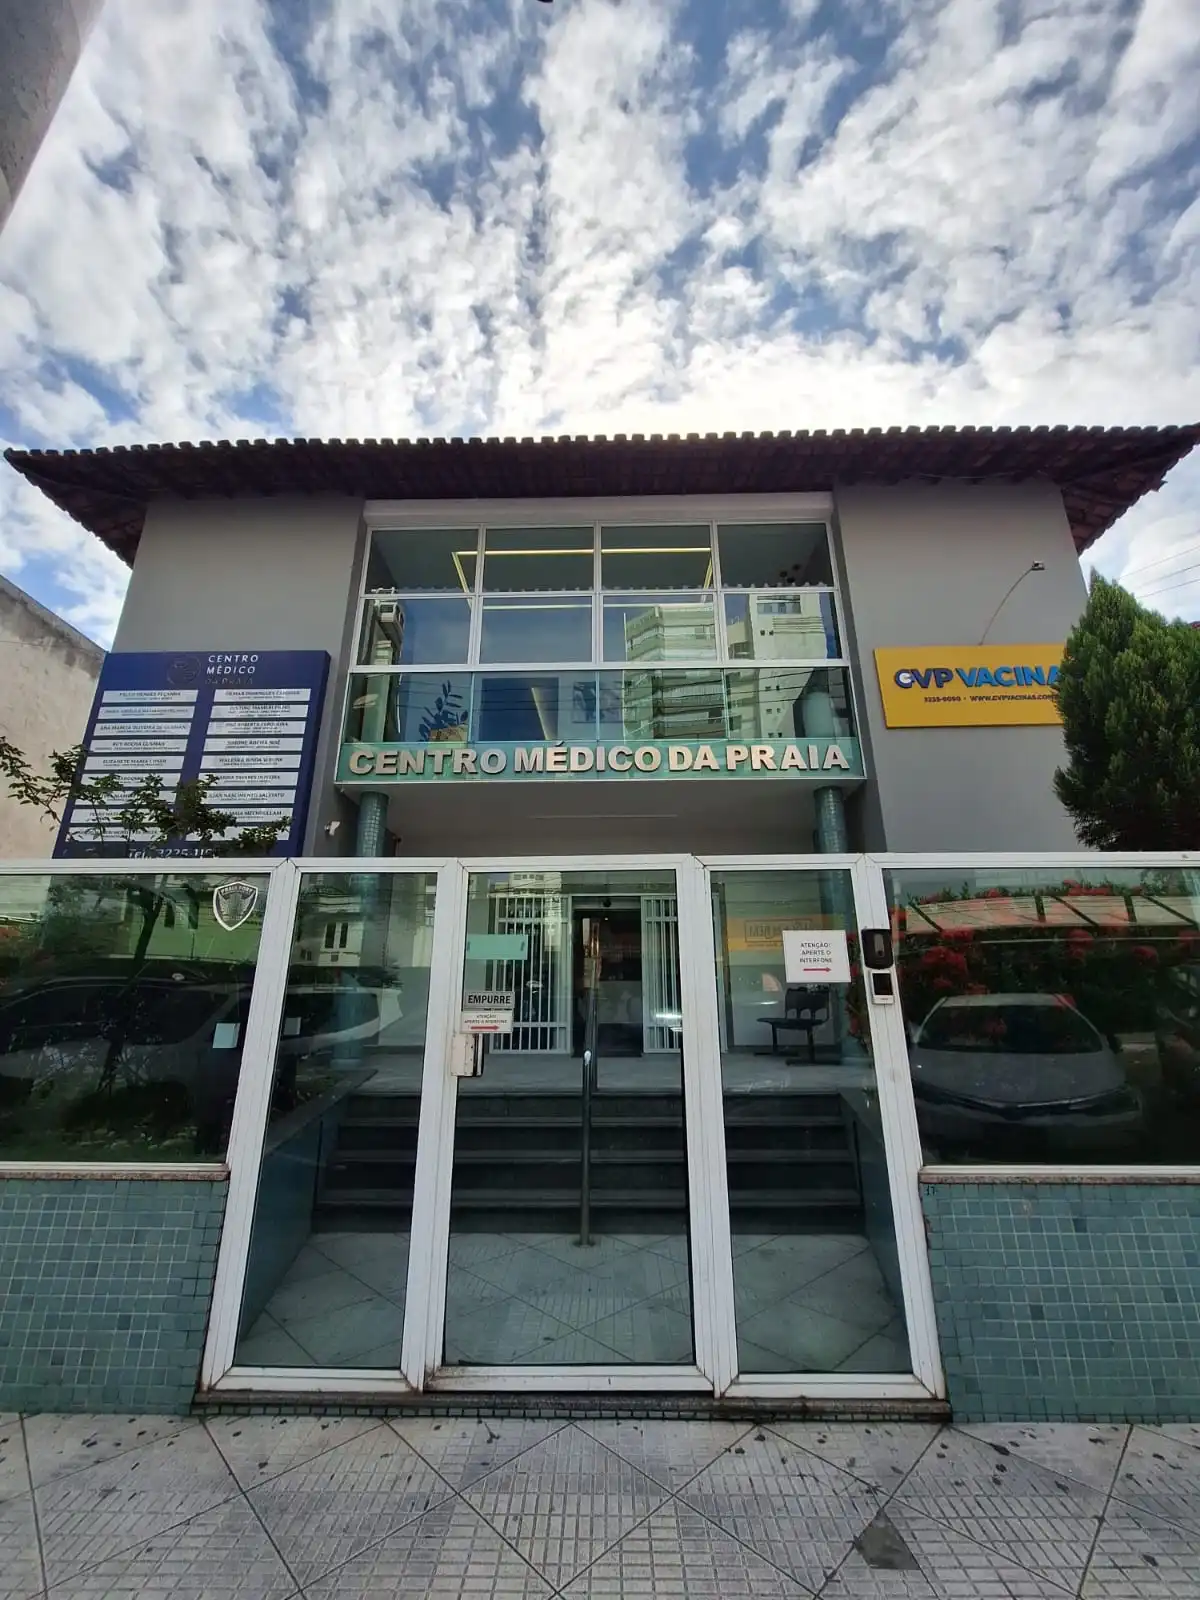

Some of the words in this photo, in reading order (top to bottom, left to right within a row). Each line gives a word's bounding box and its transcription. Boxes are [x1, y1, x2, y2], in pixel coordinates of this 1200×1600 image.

[208, 654, 259, 663] CENTRO
[206, 665, 256, 675] MÉDICO
[955, 664, 1062, 688] VACINA
[349, 748, 507, 775] CENTRO
[514, 741, 662, 773] MÉDICO
[668, 745, 720, 772] DA
[725, 744, 851, 771] PRAIA
[467, 994, 511, 1004] EMPURRE
